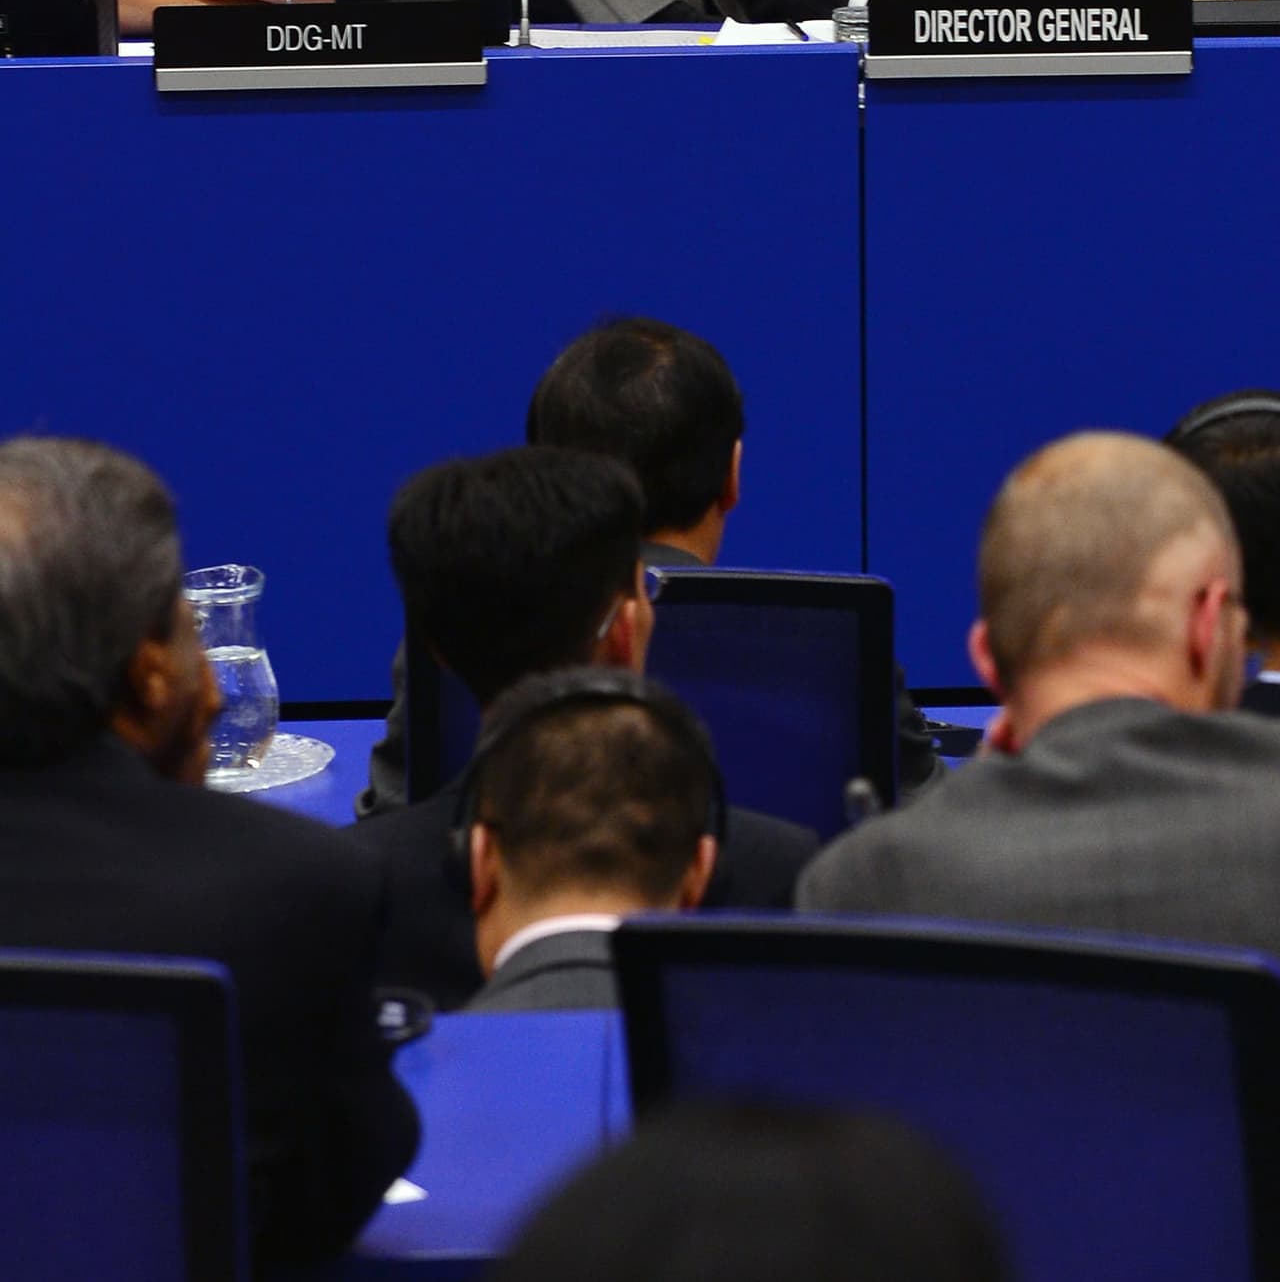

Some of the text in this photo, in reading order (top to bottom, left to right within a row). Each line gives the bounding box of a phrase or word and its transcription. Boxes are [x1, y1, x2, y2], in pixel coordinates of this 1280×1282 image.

[266, 23, 368, 52] DDG-MT
[914, 8, 1149, 43] DIRECTOR GENERAL
